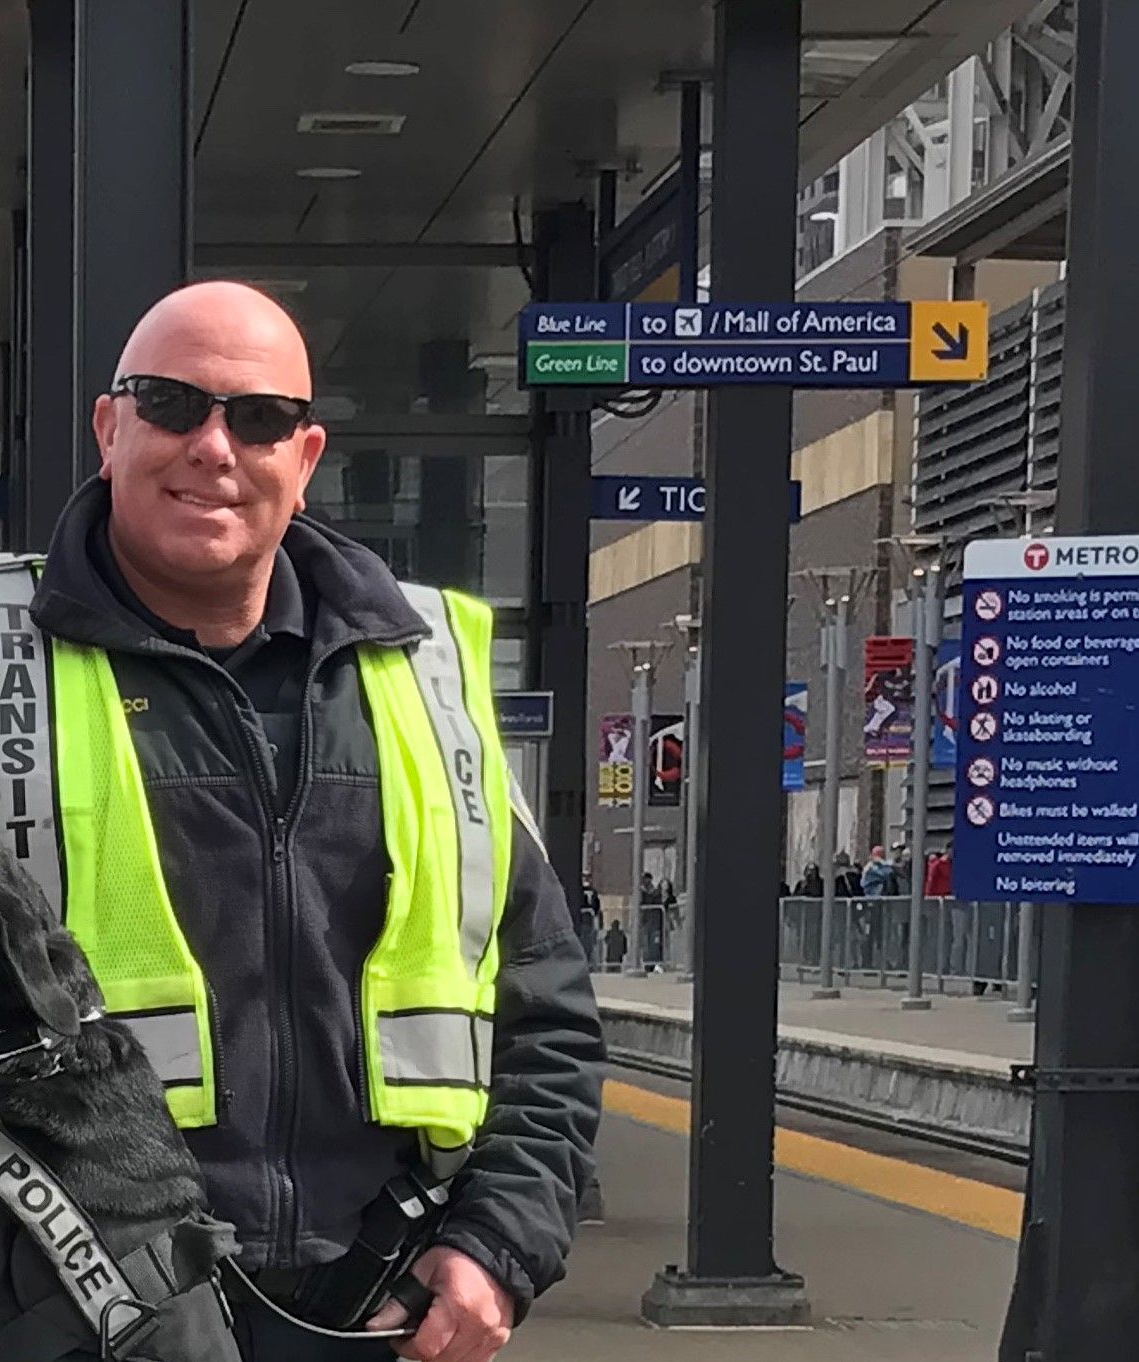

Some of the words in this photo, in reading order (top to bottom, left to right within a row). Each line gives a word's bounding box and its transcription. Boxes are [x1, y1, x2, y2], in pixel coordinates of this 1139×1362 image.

[536, 315, 569, 333] Blue
[575, 315, 607, 333] Line
[642, 316, 667, 334] to
[724, 311, 769, 333] Mall
[776, 310, 801, 333] of
[802, 311, 896, 333] America
[535, 353, 582, 373] Green
[587, 354, 618, 372] Line
[641, 357, 666, 374] to
[673, 351, 792, 374] downtown
[799, 350, 827, 373] St.
[832, 350, 878, 373] Paul
[1056, 545, 1139, 565] METRO
[1008, 590, 1030, 603] No
[1034, 589, 1087, 607] smoking
[1090, 589, 1101, 602] is
[1008, 608, 1052, 620] station
[1055, 609, 1089, 620] areas
[1092, 609, 1109, 619] or
[1111, 608, 1129, 619] on
[1006, 636, 1028, 650] No
[1031, 635, 1062, 650] food
[1064, 639, 1081, 650] or
[1005, 656, 1039, 670] open
[1041, 653, 1109, 667] containers
[1004, 682, 1027, 696] No
[1029, 682, 1077, 696] alcohol
[1003, 711, 1025, 725] No
[1029, 711, 1073, 728] skating
[1075, 715, 1092, 725] or
[0, 602, 37, 860] TRANSIT
[1003, 728, 1092, 745] skateboarding
[1001, 757, 1023, 771] No
[1026, 758, 1063, 771] music
[1066, 757, 1118, 771] without
[1000, 774, 1077, 792] headphones
[999, 803, 1033, 817] Bikes
[1035, 805, 1068, 817] must
[1072, 804, 1089, 817] be
[1091, 804, 1138, 817] walked
[998, 832, 1074, 846] Unattended
[1076, 833, 1113, 846] items
[997, 849, 1054, 862] removed
[1058, 849, 1136, 868] immediately
[996, 877, 1018, 891] No
[1021, 877, 1075, 895] loitering
